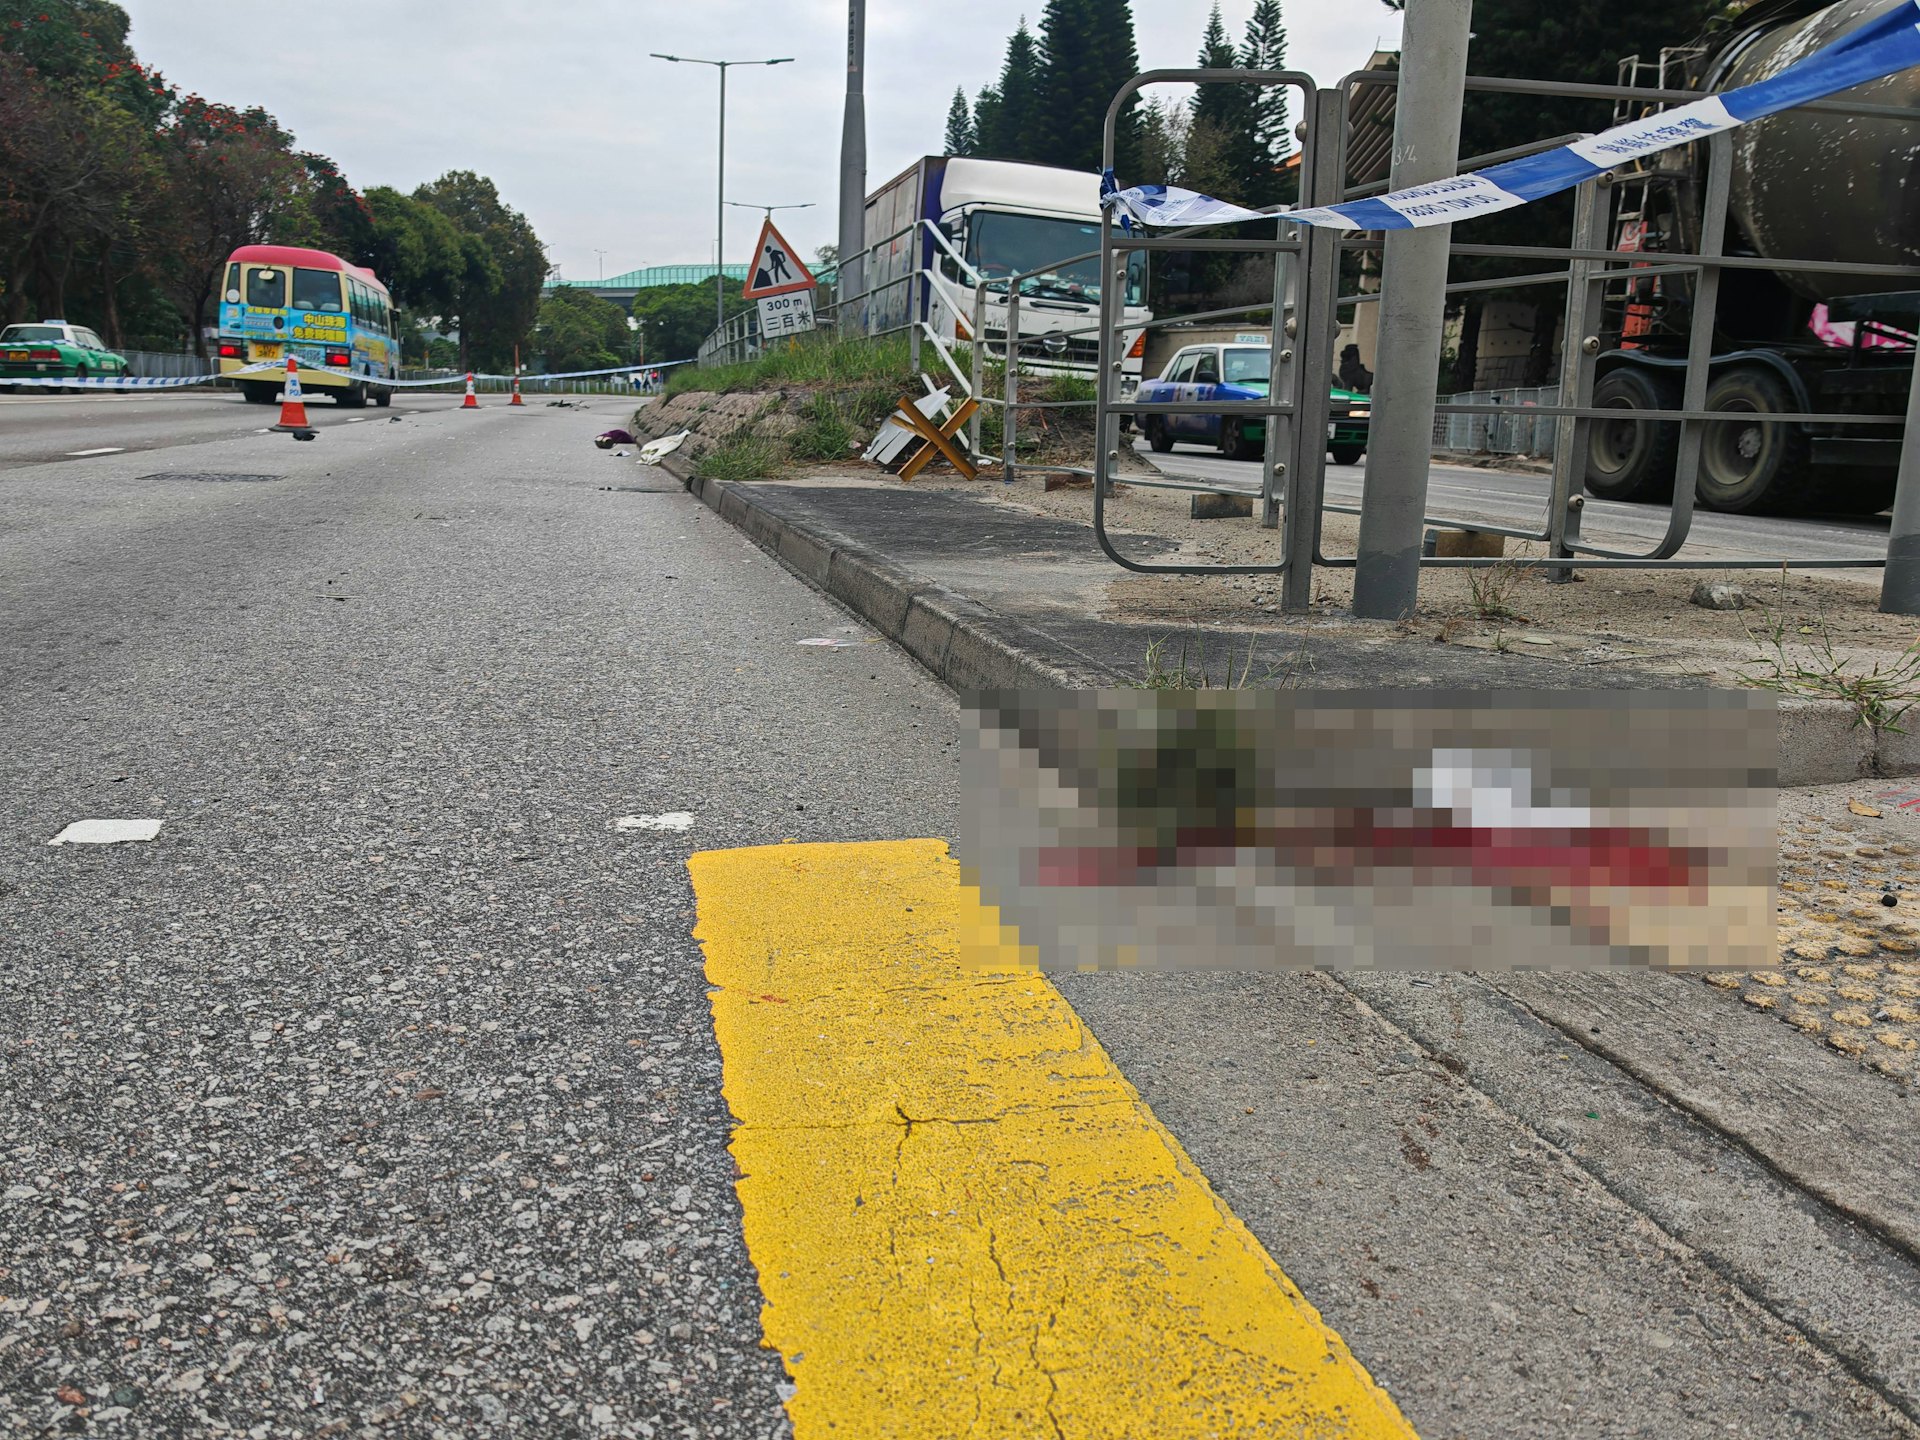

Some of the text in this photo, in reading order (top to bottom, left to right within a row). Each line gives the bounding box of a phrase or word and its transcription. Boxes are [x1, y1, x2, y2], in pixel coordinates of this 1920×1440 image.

[767, 299, 803, 311] 300 m
[766, 311, 811, 331] 三百米
